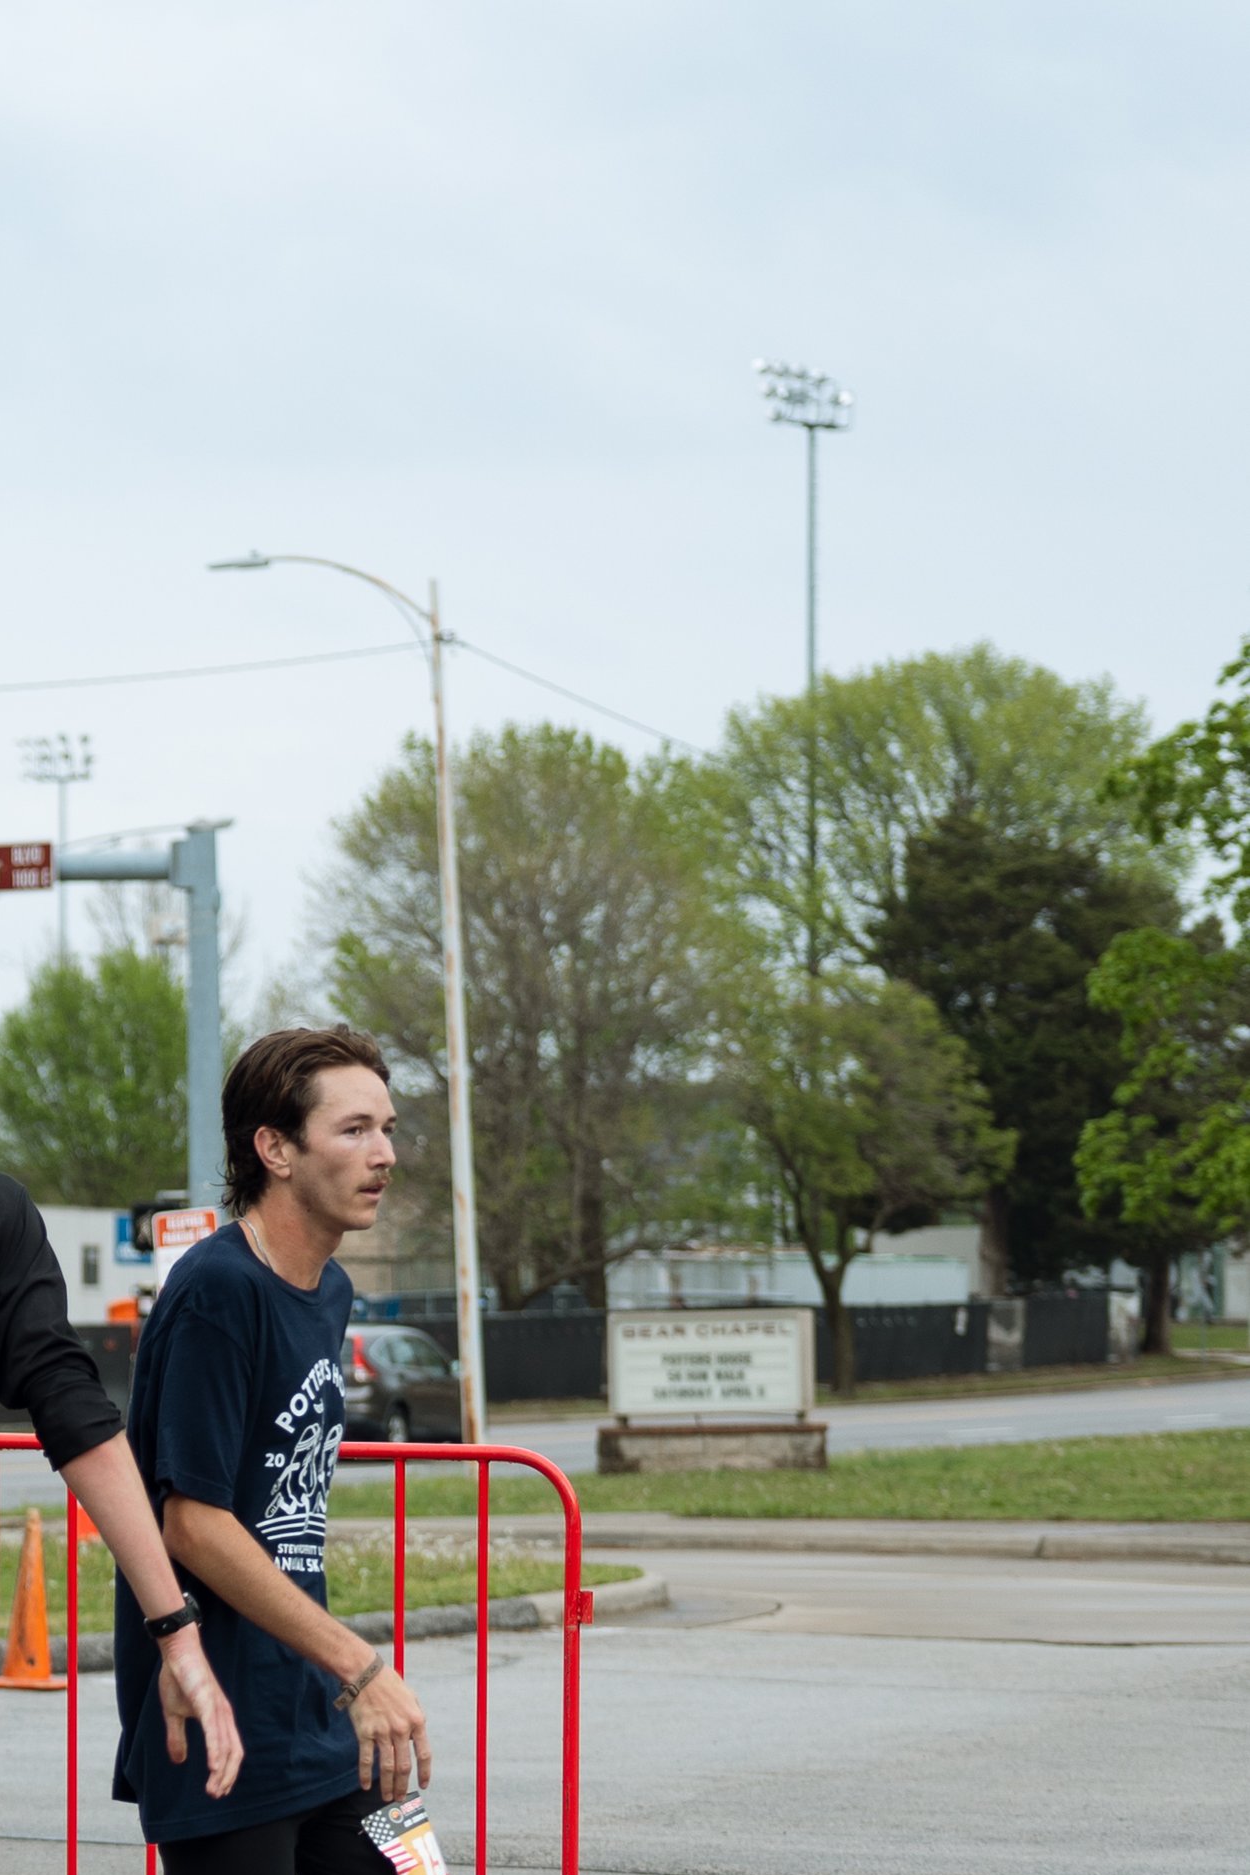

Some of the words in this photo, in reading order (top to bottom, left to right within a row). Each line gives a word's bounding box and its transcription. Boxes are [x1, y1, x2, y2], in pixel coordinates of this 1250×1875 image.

[623, 1324, 686, 1338] BEAR
[695, 1320, 791, 1335] CHAPEL
[275, 1359, 331, 1434] POTTERS
[265, 1453, 285, 1467] 20
